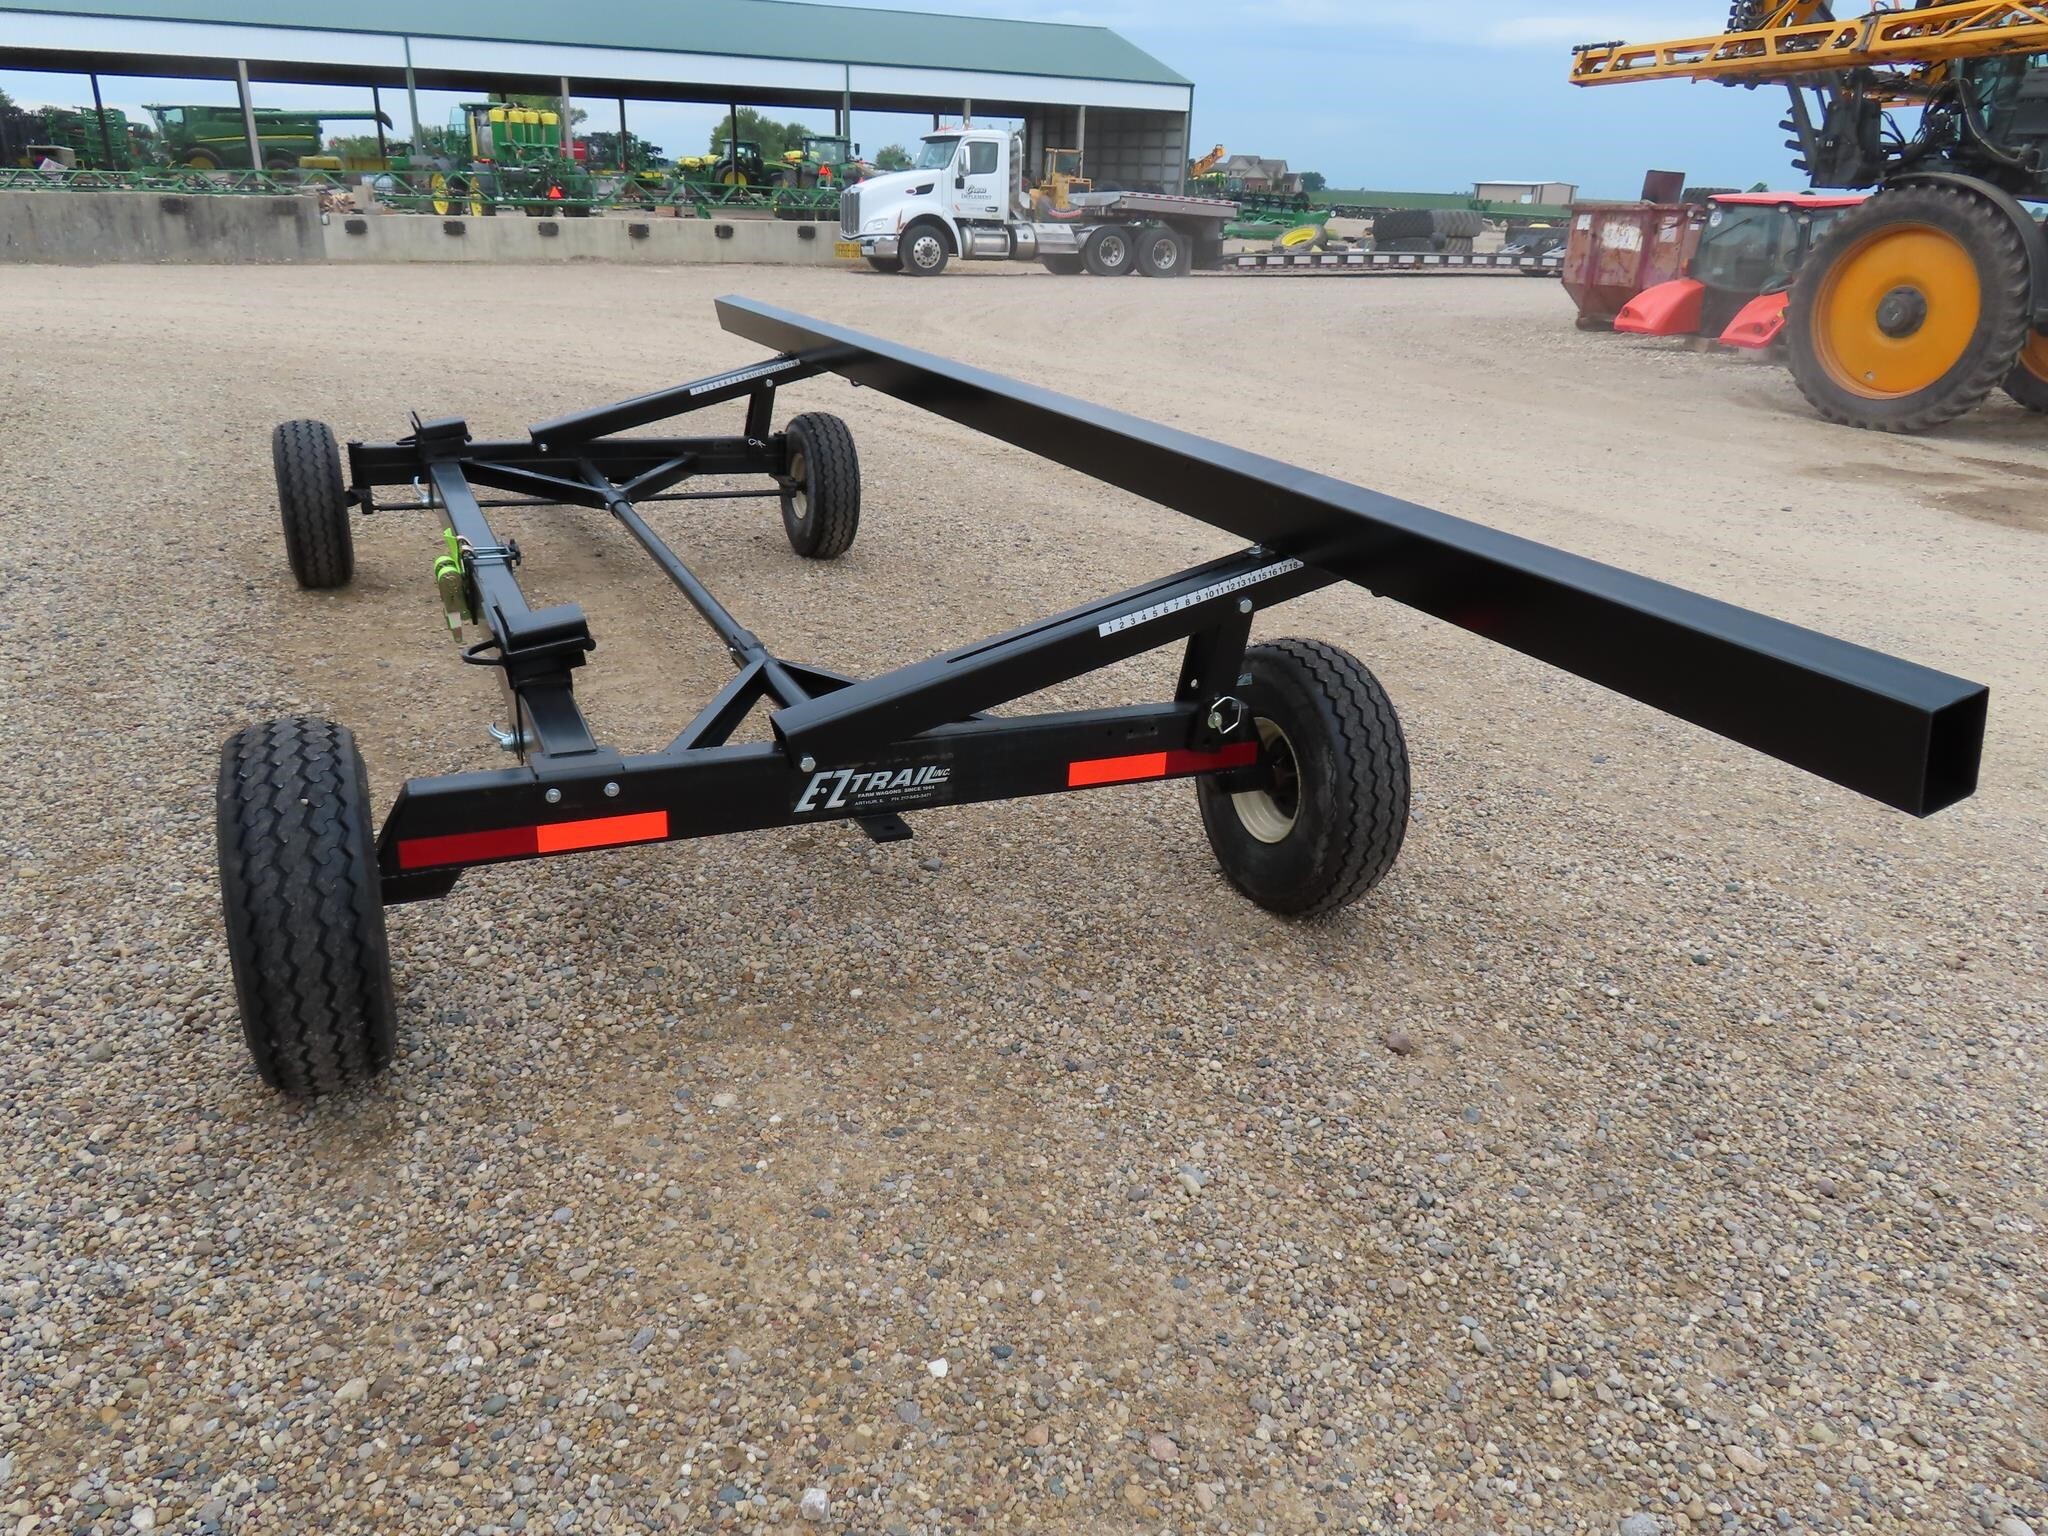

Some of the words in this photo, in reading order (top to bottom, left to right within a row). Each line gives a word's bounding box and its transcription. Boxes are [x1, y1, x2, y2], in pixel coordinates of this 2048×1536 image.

[1119, 621, 1125, 629] 2
[1130, 617, 1136, 625] 3
[1185, 598, 1191, 606] 8
[1205, 590, 1214, 598] 10
[1226, 583, 1235, 591] 12
[1237, 579, 1246, 587] 13
[1247, 576, 1256, 584] 14
[1258, 572, 1267, 580] 15
[1269, 569, 1278, 577] 16
[1279, 565, 1287, 573] 17
[1289, 561, 1298, 569] 18
[849, 766, 949, 793] TRAIL
